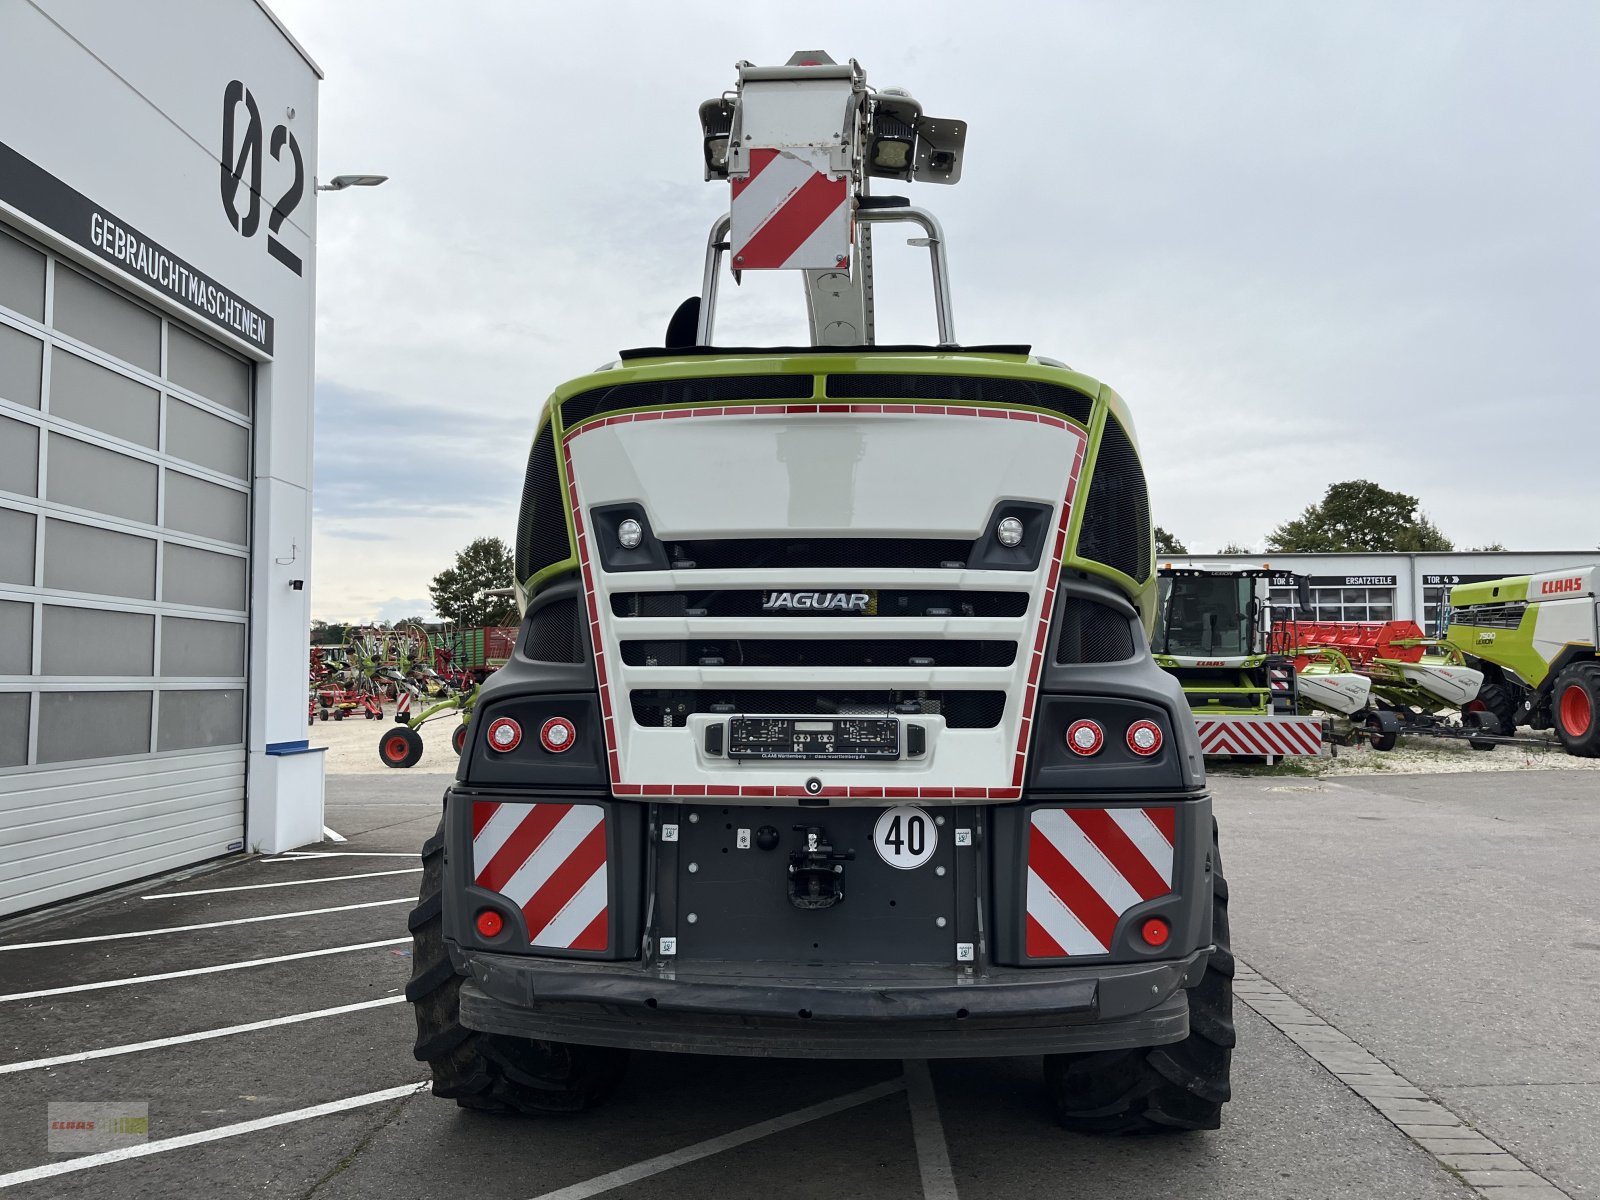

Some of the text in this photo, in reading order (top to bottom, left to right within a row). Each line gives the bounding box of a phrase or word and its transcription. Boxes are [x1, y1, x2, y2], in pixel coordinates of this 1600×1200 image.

[220, 79, 304, 278] 02
[90, 212, 266, 345] GEBRAUCHTMASCHINEN
[1345, 577, 1392, 585] ERSATZTEILE
[1427, 576, 1449, 584] TOR 4
[1541, 577, 1582, 594] CLAAS
[763, 592, 870, 609] JAGUAR
[884, 815, 926, 856] 40
